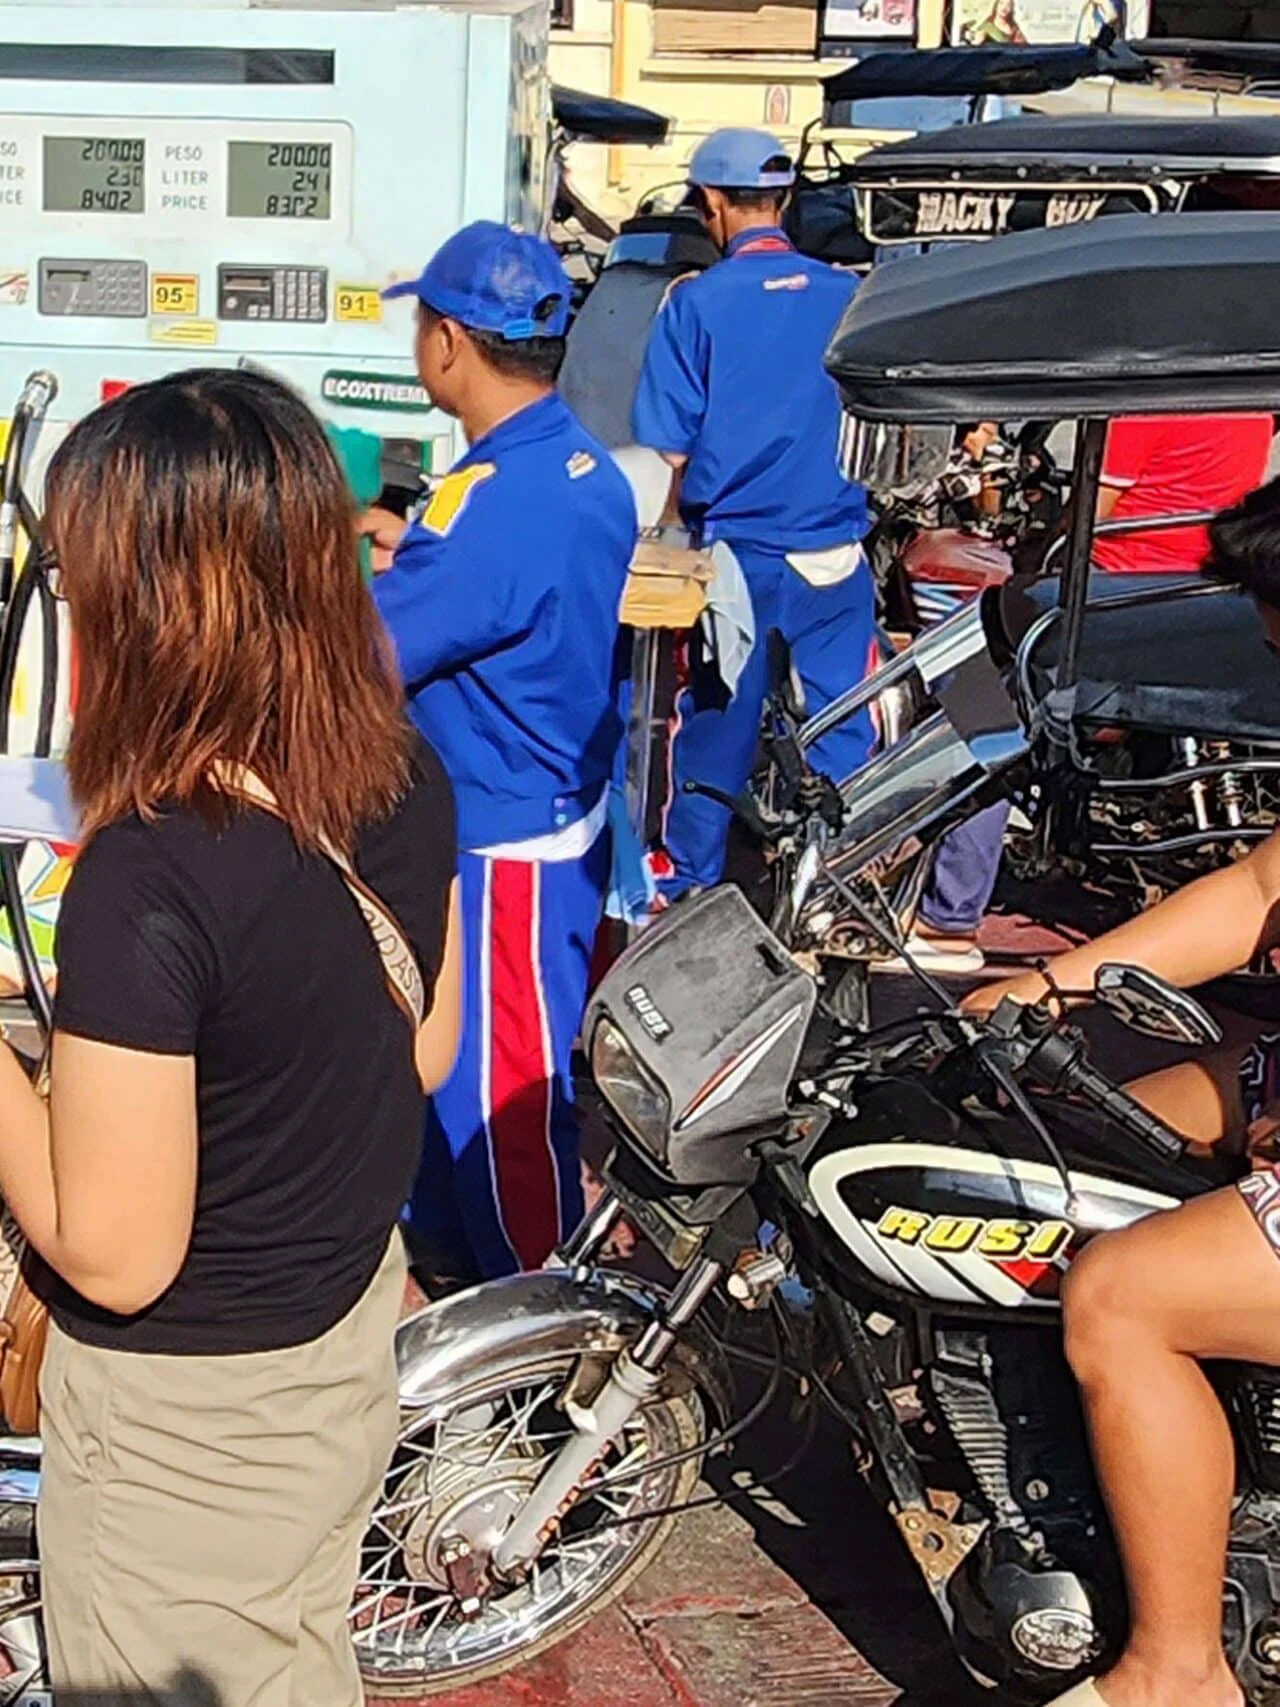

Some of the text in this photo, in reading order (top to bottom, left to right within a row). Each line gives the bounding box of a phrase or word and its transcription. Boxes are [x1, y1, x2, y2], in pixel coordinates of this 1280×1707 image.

[165, 145, 203, 161] PESO
[162, 169, 208, 185] LITER
[162, 194, 208, 211] PRICE
[915, 192, 1016, 234] MACKY
[156, 286, 184, 304] 95
[339, 294, 367, 312] 91
[877, 1207, 1070, 1259] RUSI
